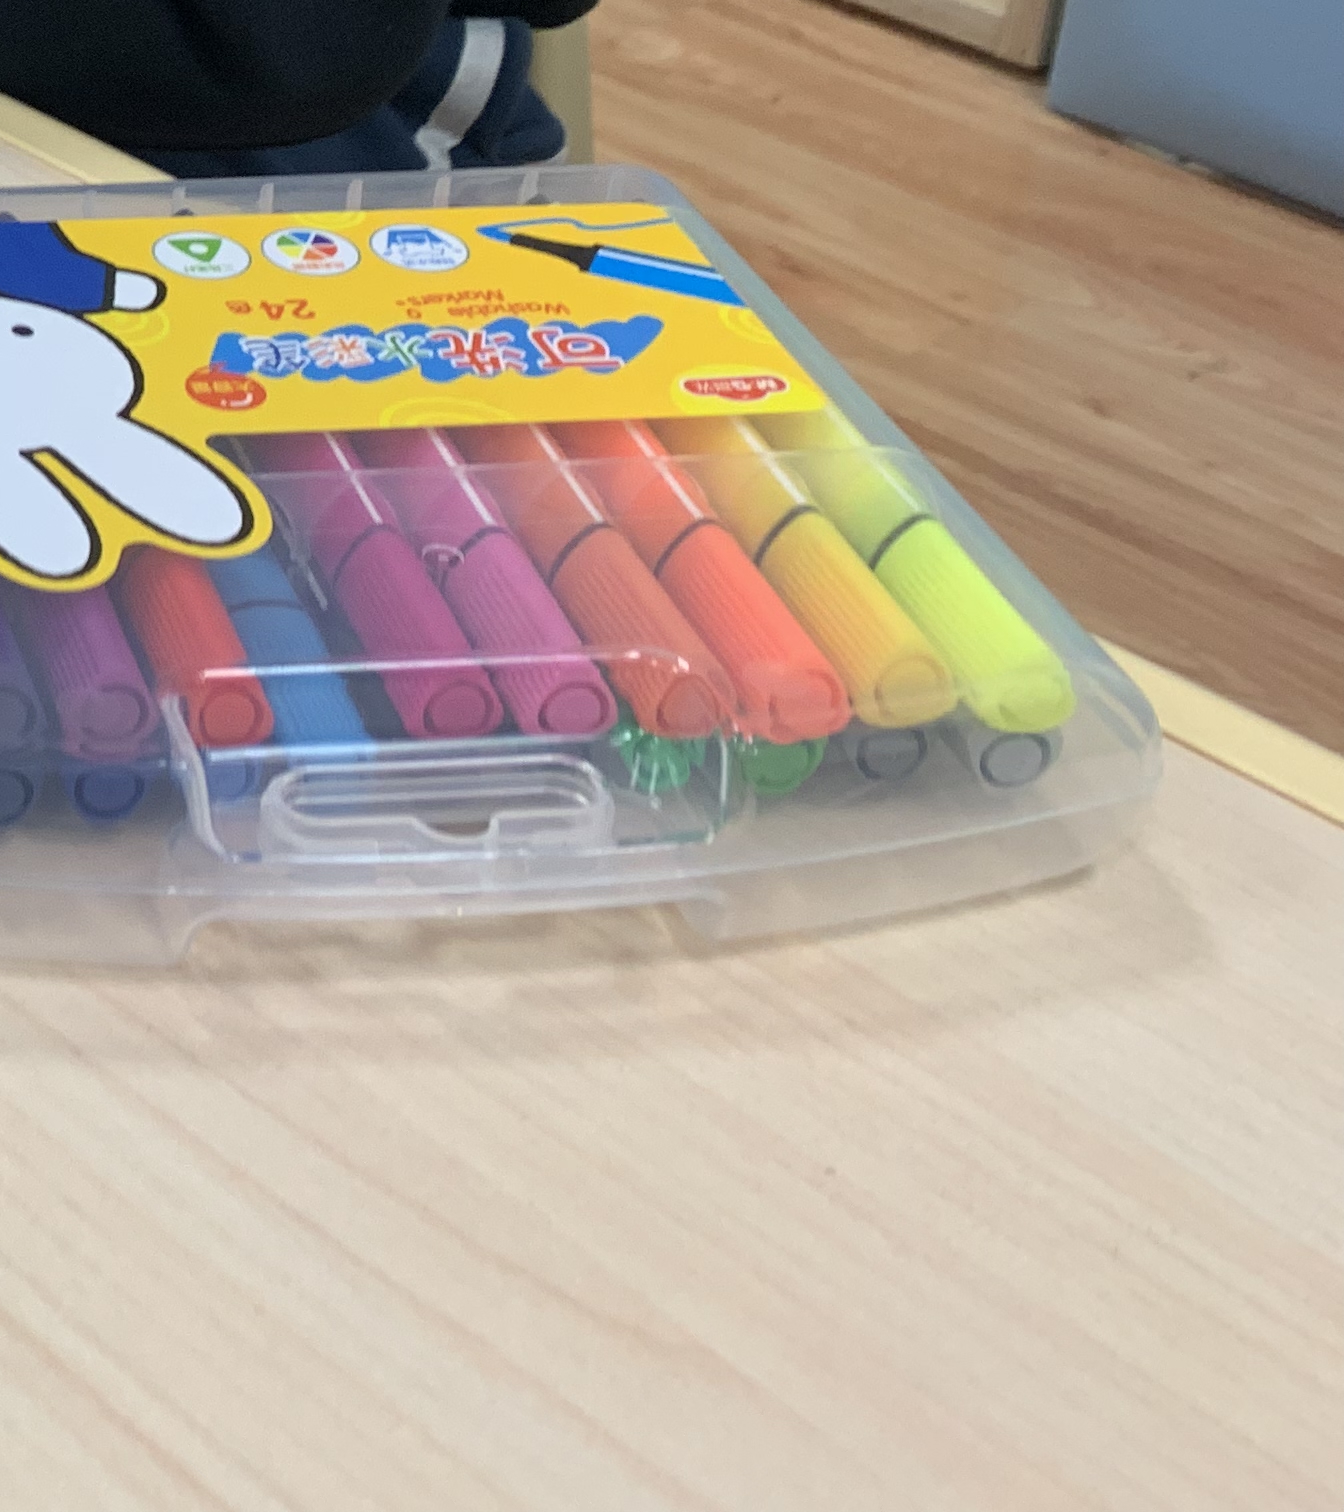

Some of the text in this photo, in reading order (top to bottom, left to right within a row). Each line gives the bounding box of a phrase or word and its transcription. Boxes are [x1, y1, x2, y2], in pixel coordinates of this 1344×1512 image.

[239, 325, 626, 376] 可洗水彩笔
